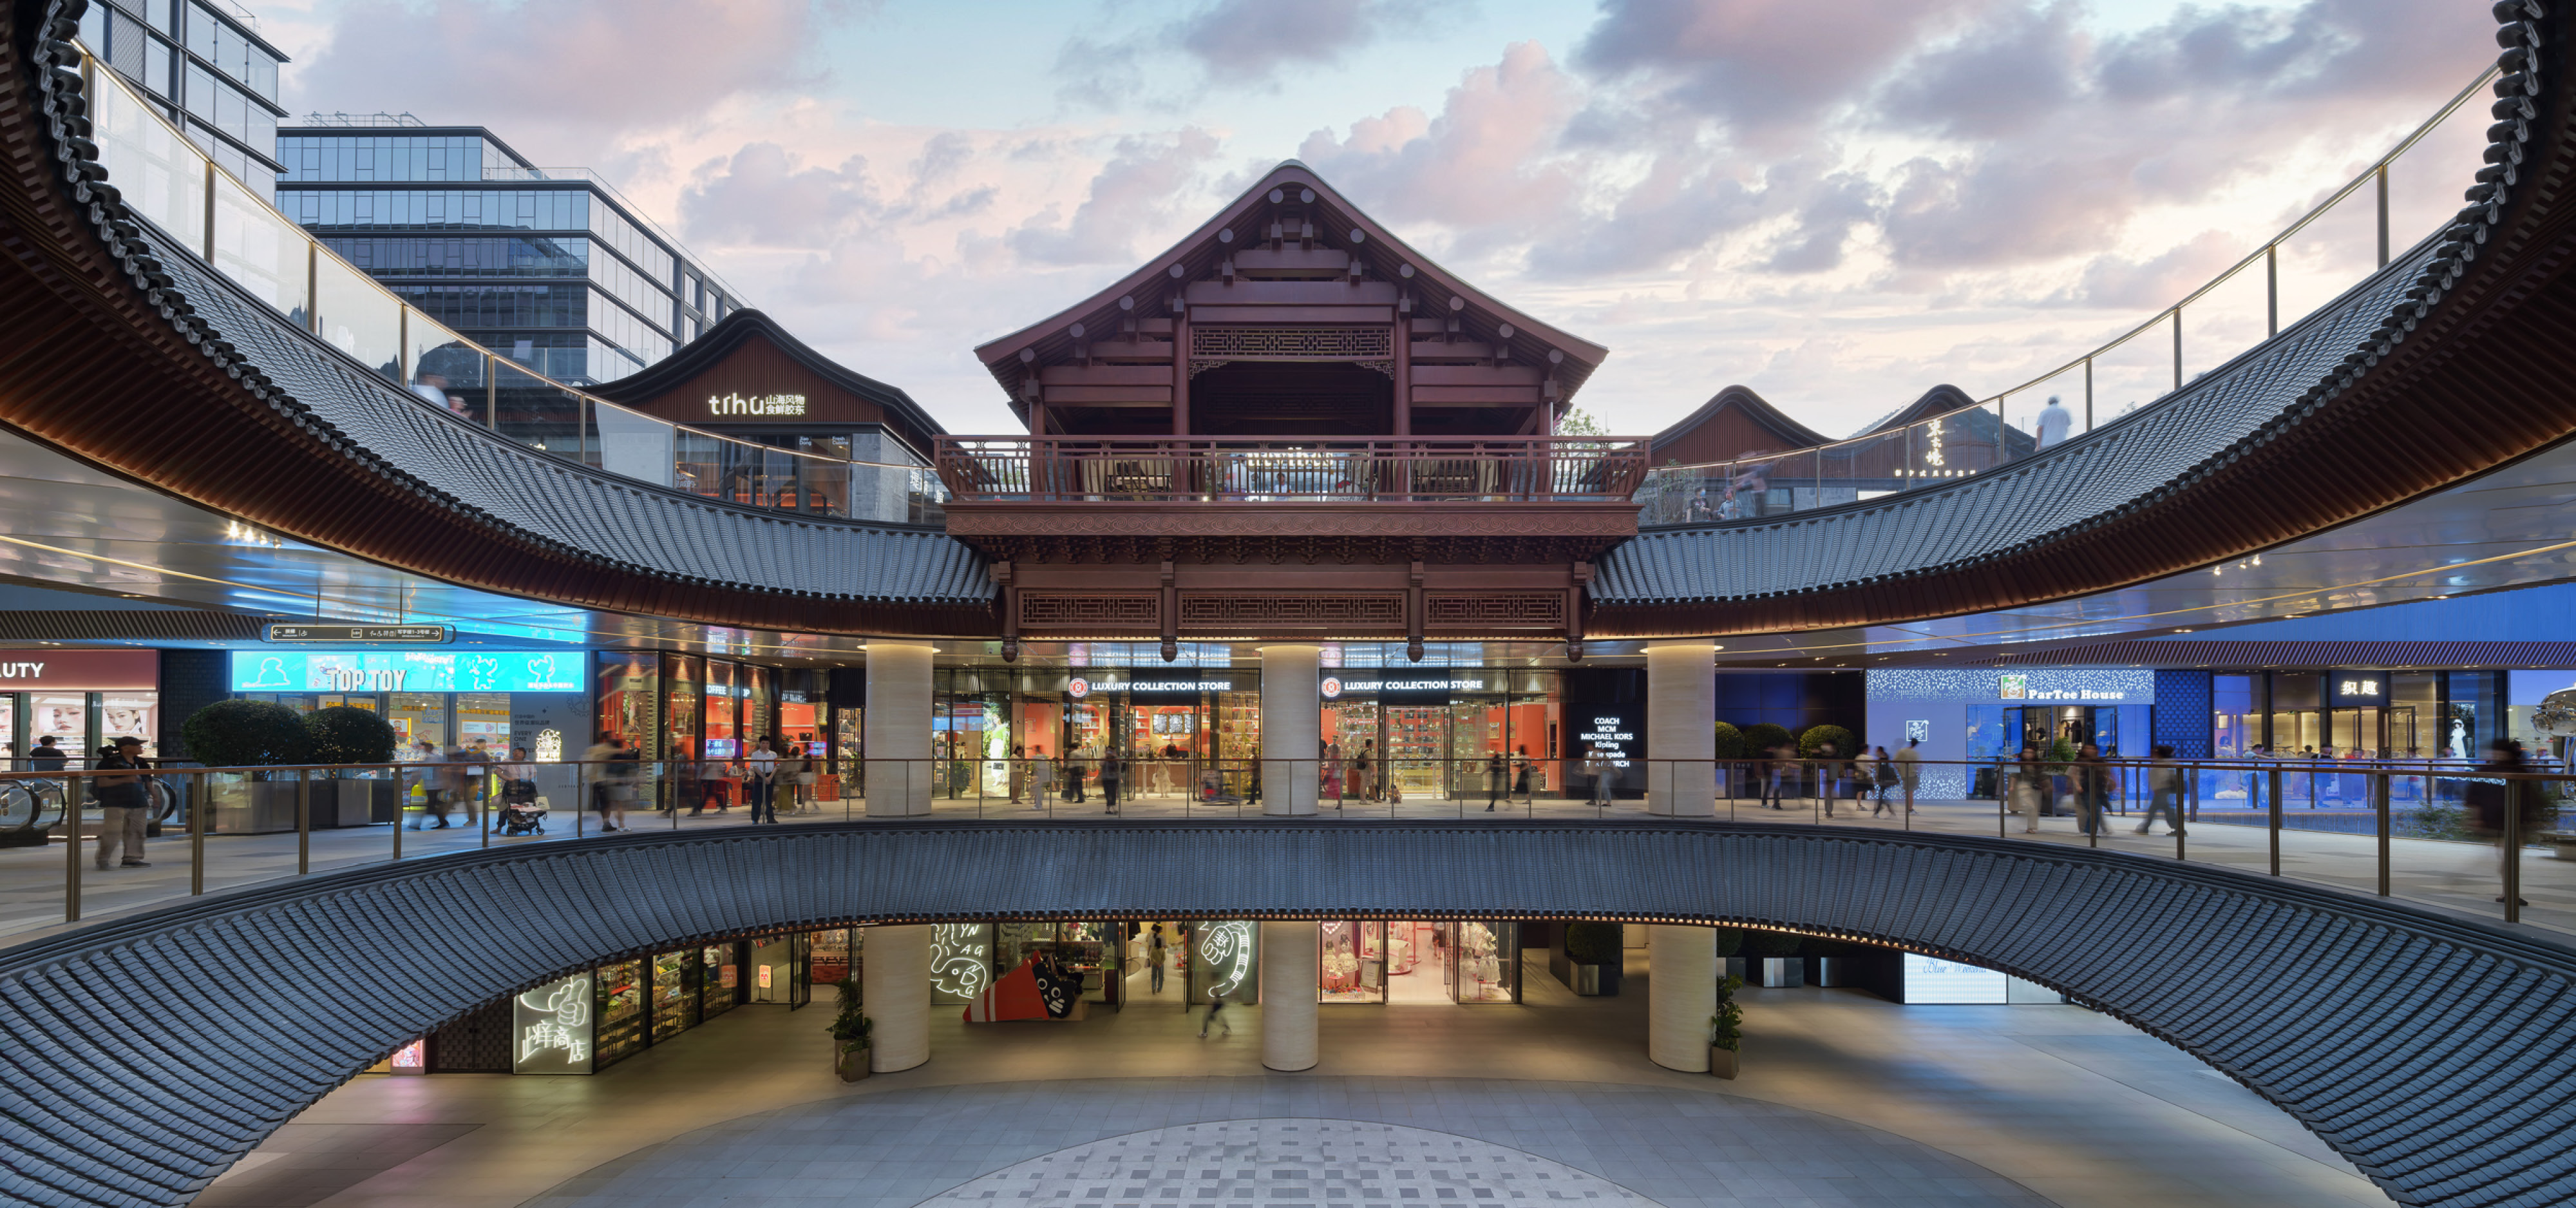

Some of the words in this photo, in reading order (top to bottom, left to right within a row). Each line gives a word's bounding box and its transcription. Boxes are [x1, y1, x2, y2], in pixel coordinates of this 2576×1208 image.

[766, 394, 805, 405] 山海风物
[766, 405, 805, 415] 食鲜胶东
[0, 662, 44, 678] UTY
[327, 669, 366, 691] TOP
[368, 669, 407, 691] TOY
[1345, 682, 1383, 690] LUXURY
[1385, 681, 1448, 689] COLLECTION
[1450, 680, 1482, 689] STORE
[1092, 682, 1131, 691] LUXURY
[2340, 680, 2379, 695] 织趣
[2027, 689, 2078, 699] ParTee
[2080, 689, 2124, 699] House
[1595, 741, 1620, 750] Kipling
[1923, 958, 1947, 973] Blue
[518, 1019, 587, 1064] 止痒商店
